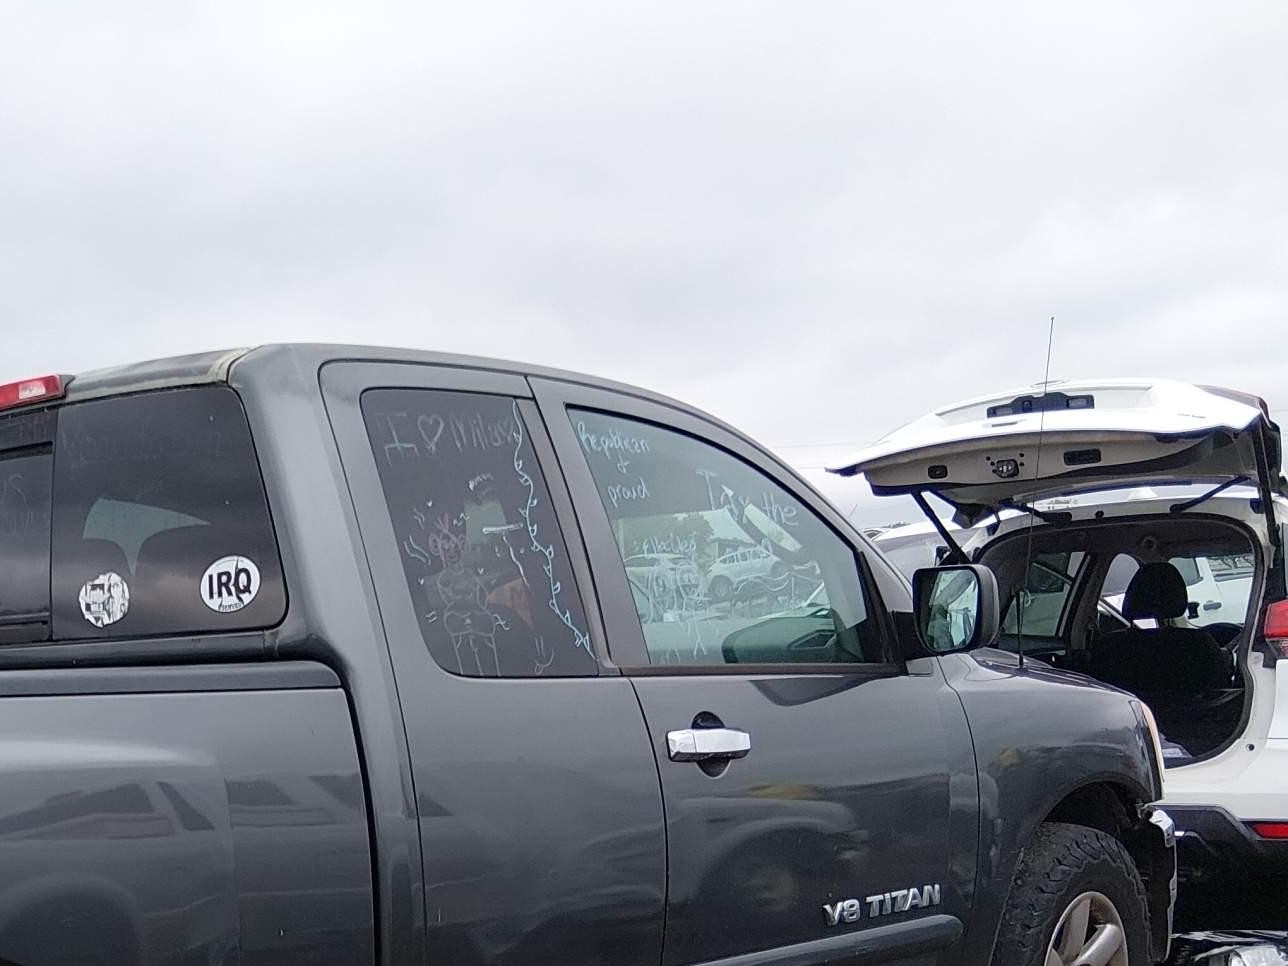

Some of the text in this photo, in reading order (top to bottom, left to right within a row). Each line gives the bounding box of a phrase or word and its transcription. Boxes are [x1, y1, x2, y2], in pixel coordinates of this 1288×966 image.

[607, 476, 650, 508] proud
[208, 567, 252, 600] IRQ
[822, 883, 942, 926] V8 TITAN
